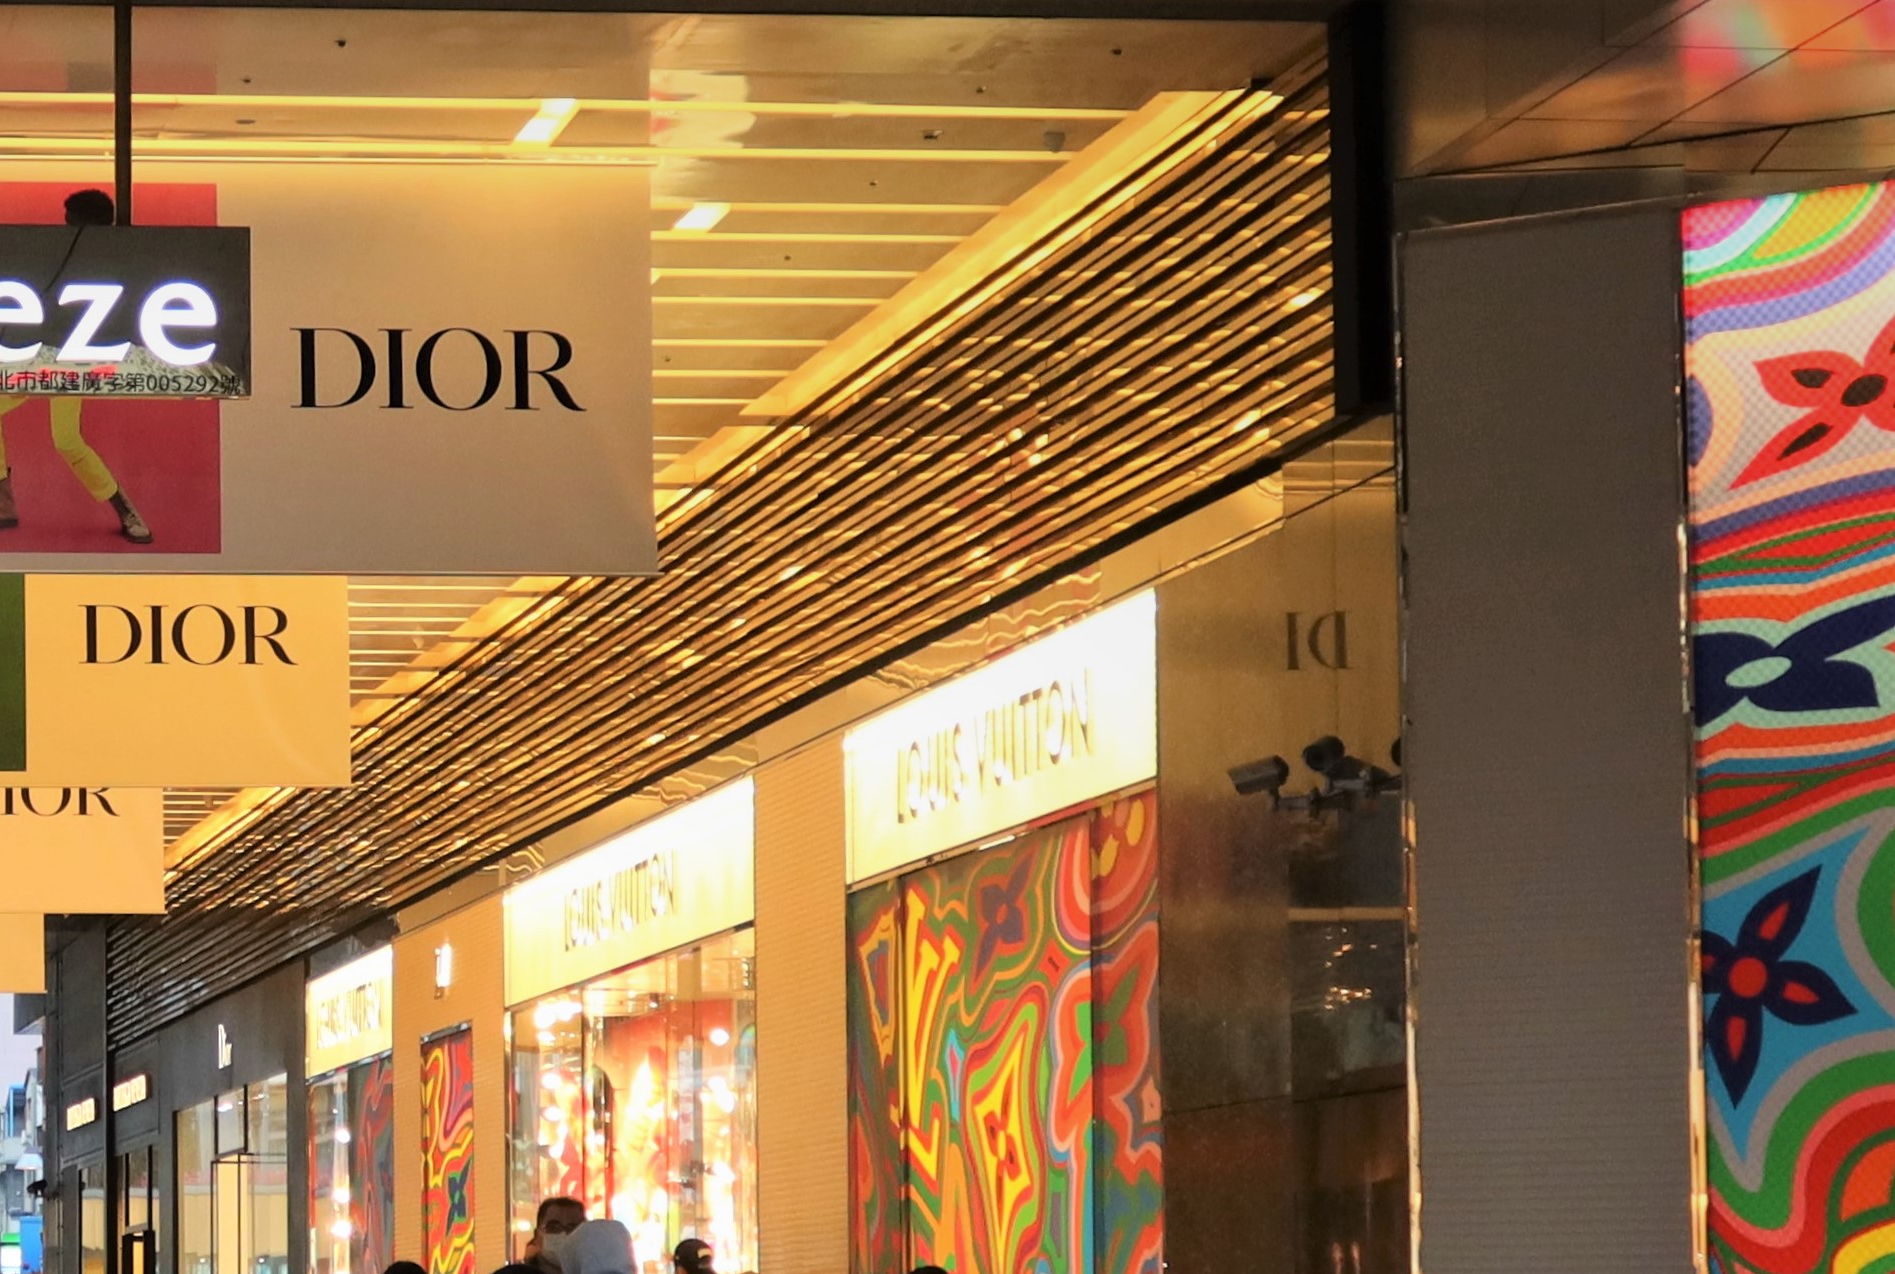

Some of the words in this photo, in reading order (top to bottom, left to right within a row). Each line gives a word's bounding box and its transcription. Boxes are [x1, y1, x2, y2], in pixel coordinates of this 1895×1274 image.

[290, 326, 587, 413] DIOR
[78, 603, 299, 666] DIOR
[897, 722, 969, 824] LOUIS
[973, 668, 1096, 797] VUITTON
